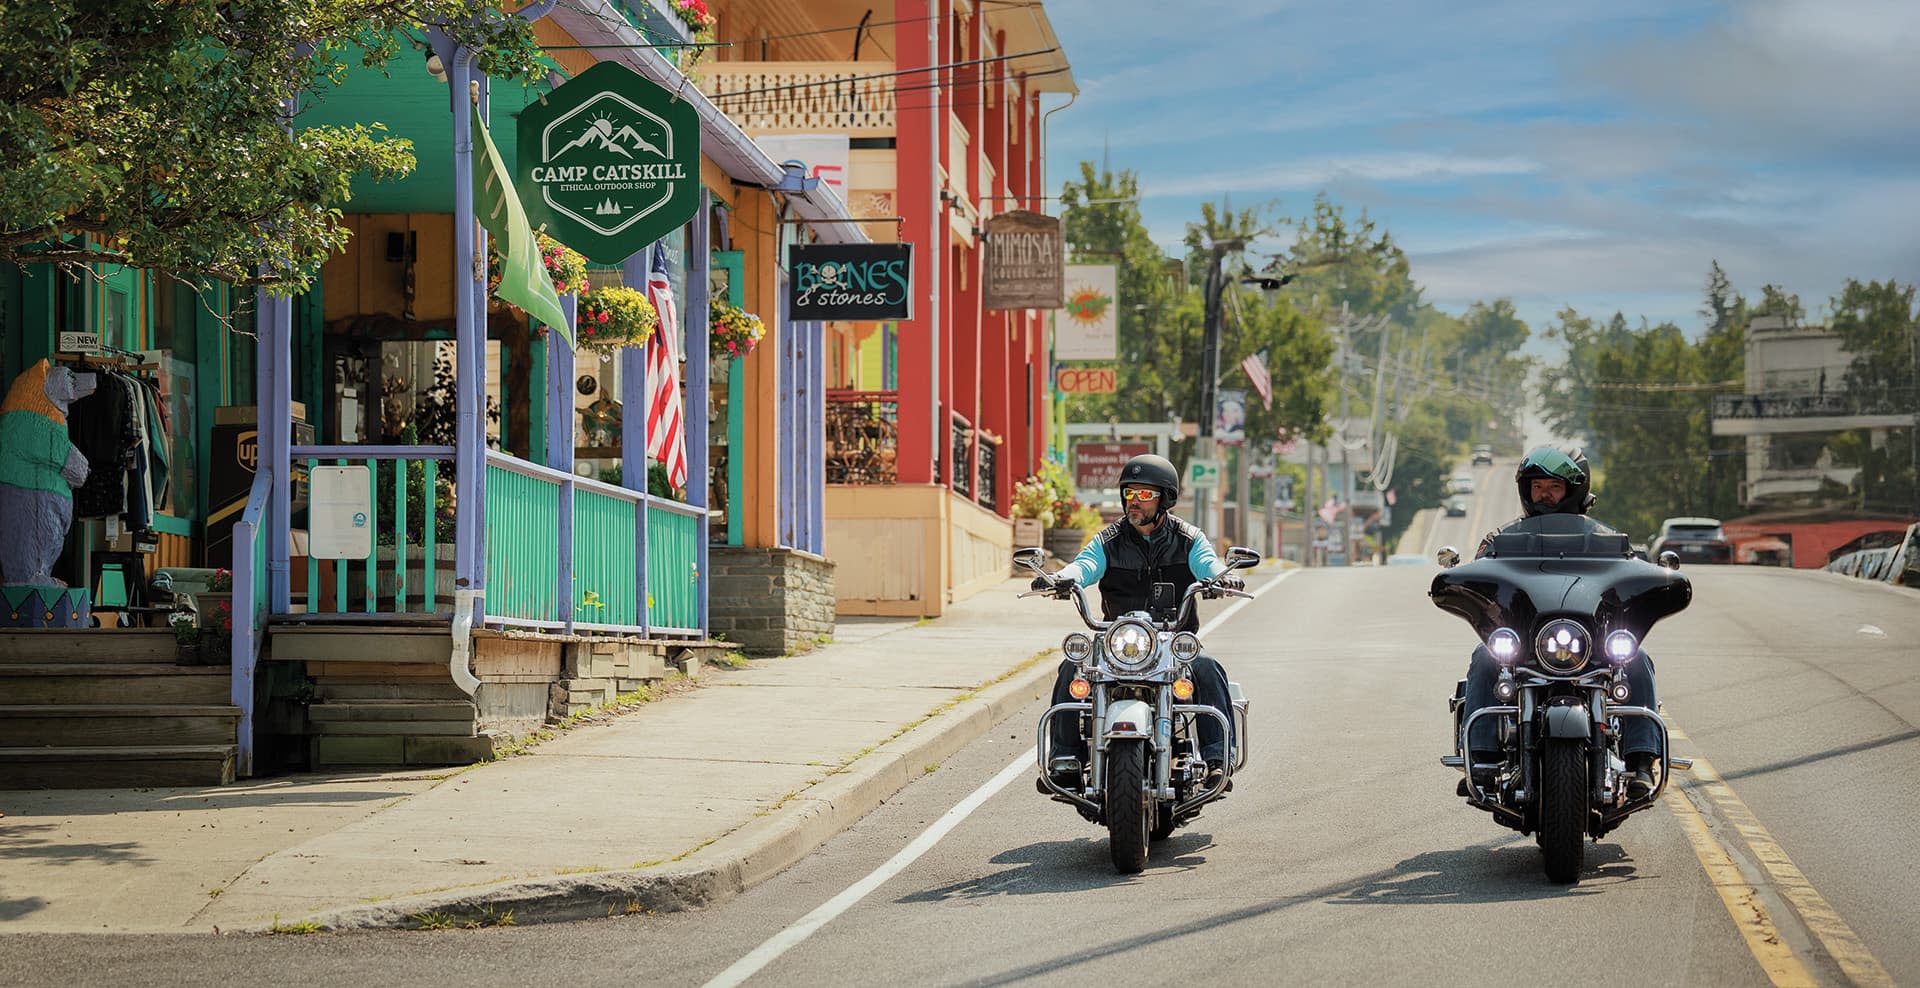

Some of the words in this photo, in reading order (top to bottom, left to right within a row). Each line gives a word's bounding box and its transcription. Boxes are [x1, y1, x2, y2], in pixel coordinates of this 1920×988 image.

[531, 166, 587, 183] CAMP
[592, 163, 687, 182] CATSKILL
[560, 183, 593, 192] ETHICAL
[594, 182, 633, 191] OUTDOOR
[634, 182, 657, 190] SHOP
[994, 233, 1054, 266] MIMOSA
[794, 260, 908, 305] BONES
[796, 287, 815, 306] &
[817, 289, 887, 306] stones
[77, 335, 98, 345] NEW
[1059, 371, 1114, 392] OPEN
[240, 444, 258, 466] up
[1192, 464, 1205, 481] P
